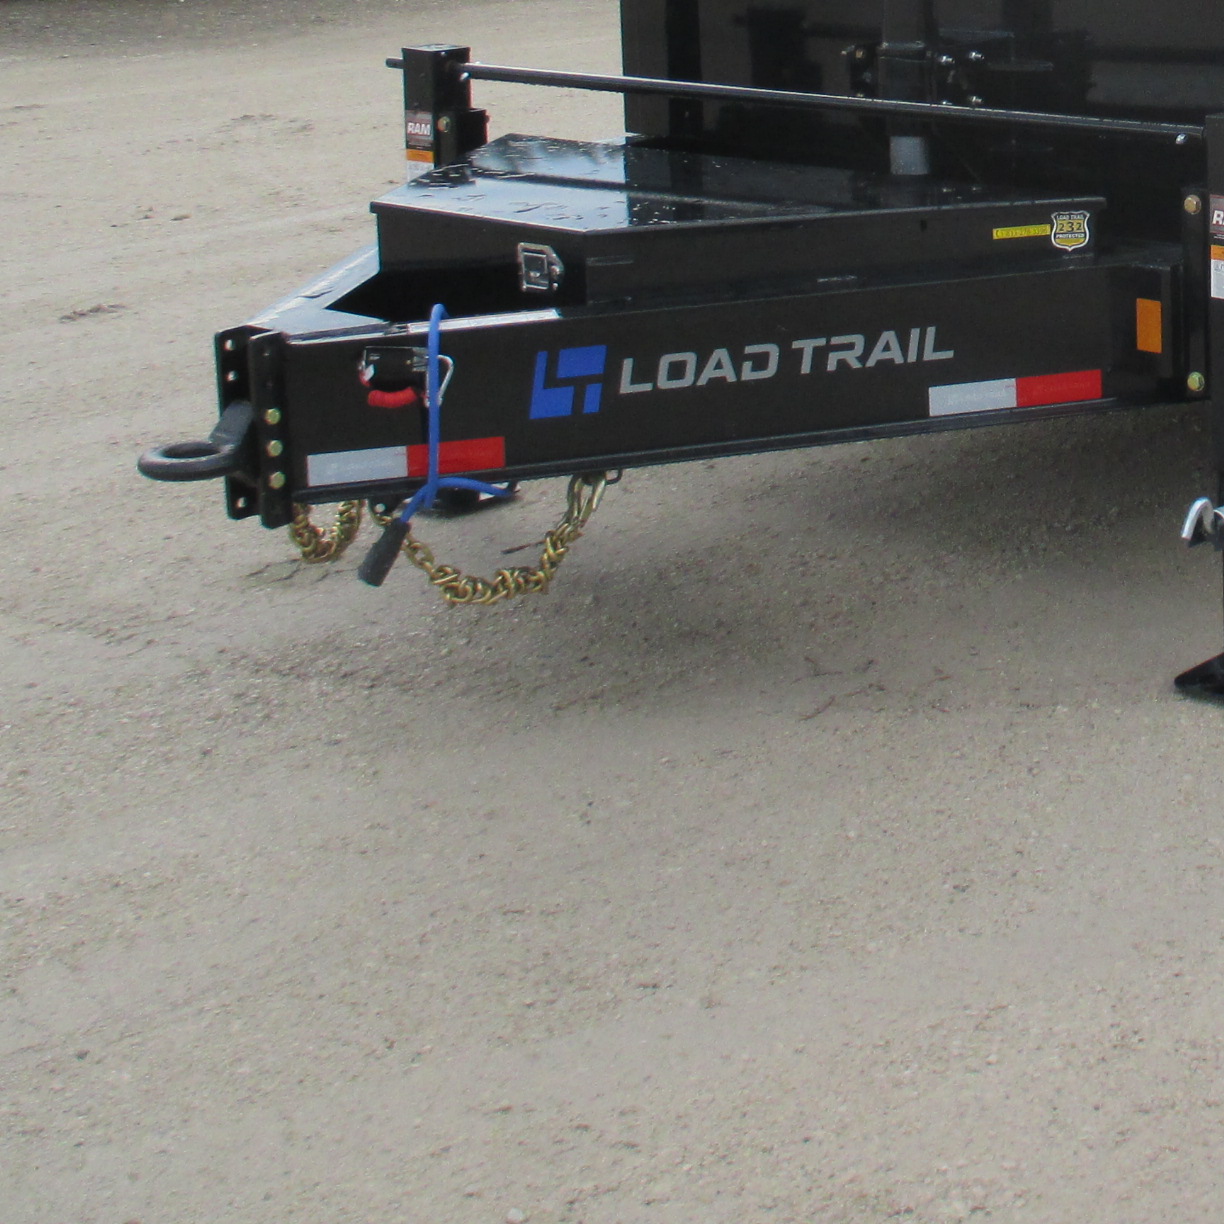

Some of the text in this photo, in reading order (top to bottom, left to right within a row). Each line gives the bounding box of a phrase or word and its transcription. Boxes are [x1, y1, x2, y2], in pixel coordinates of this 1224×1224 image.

[407, 122, 431, 136] RAM
[619, 326, 955, 395] LOAD TRAIL
